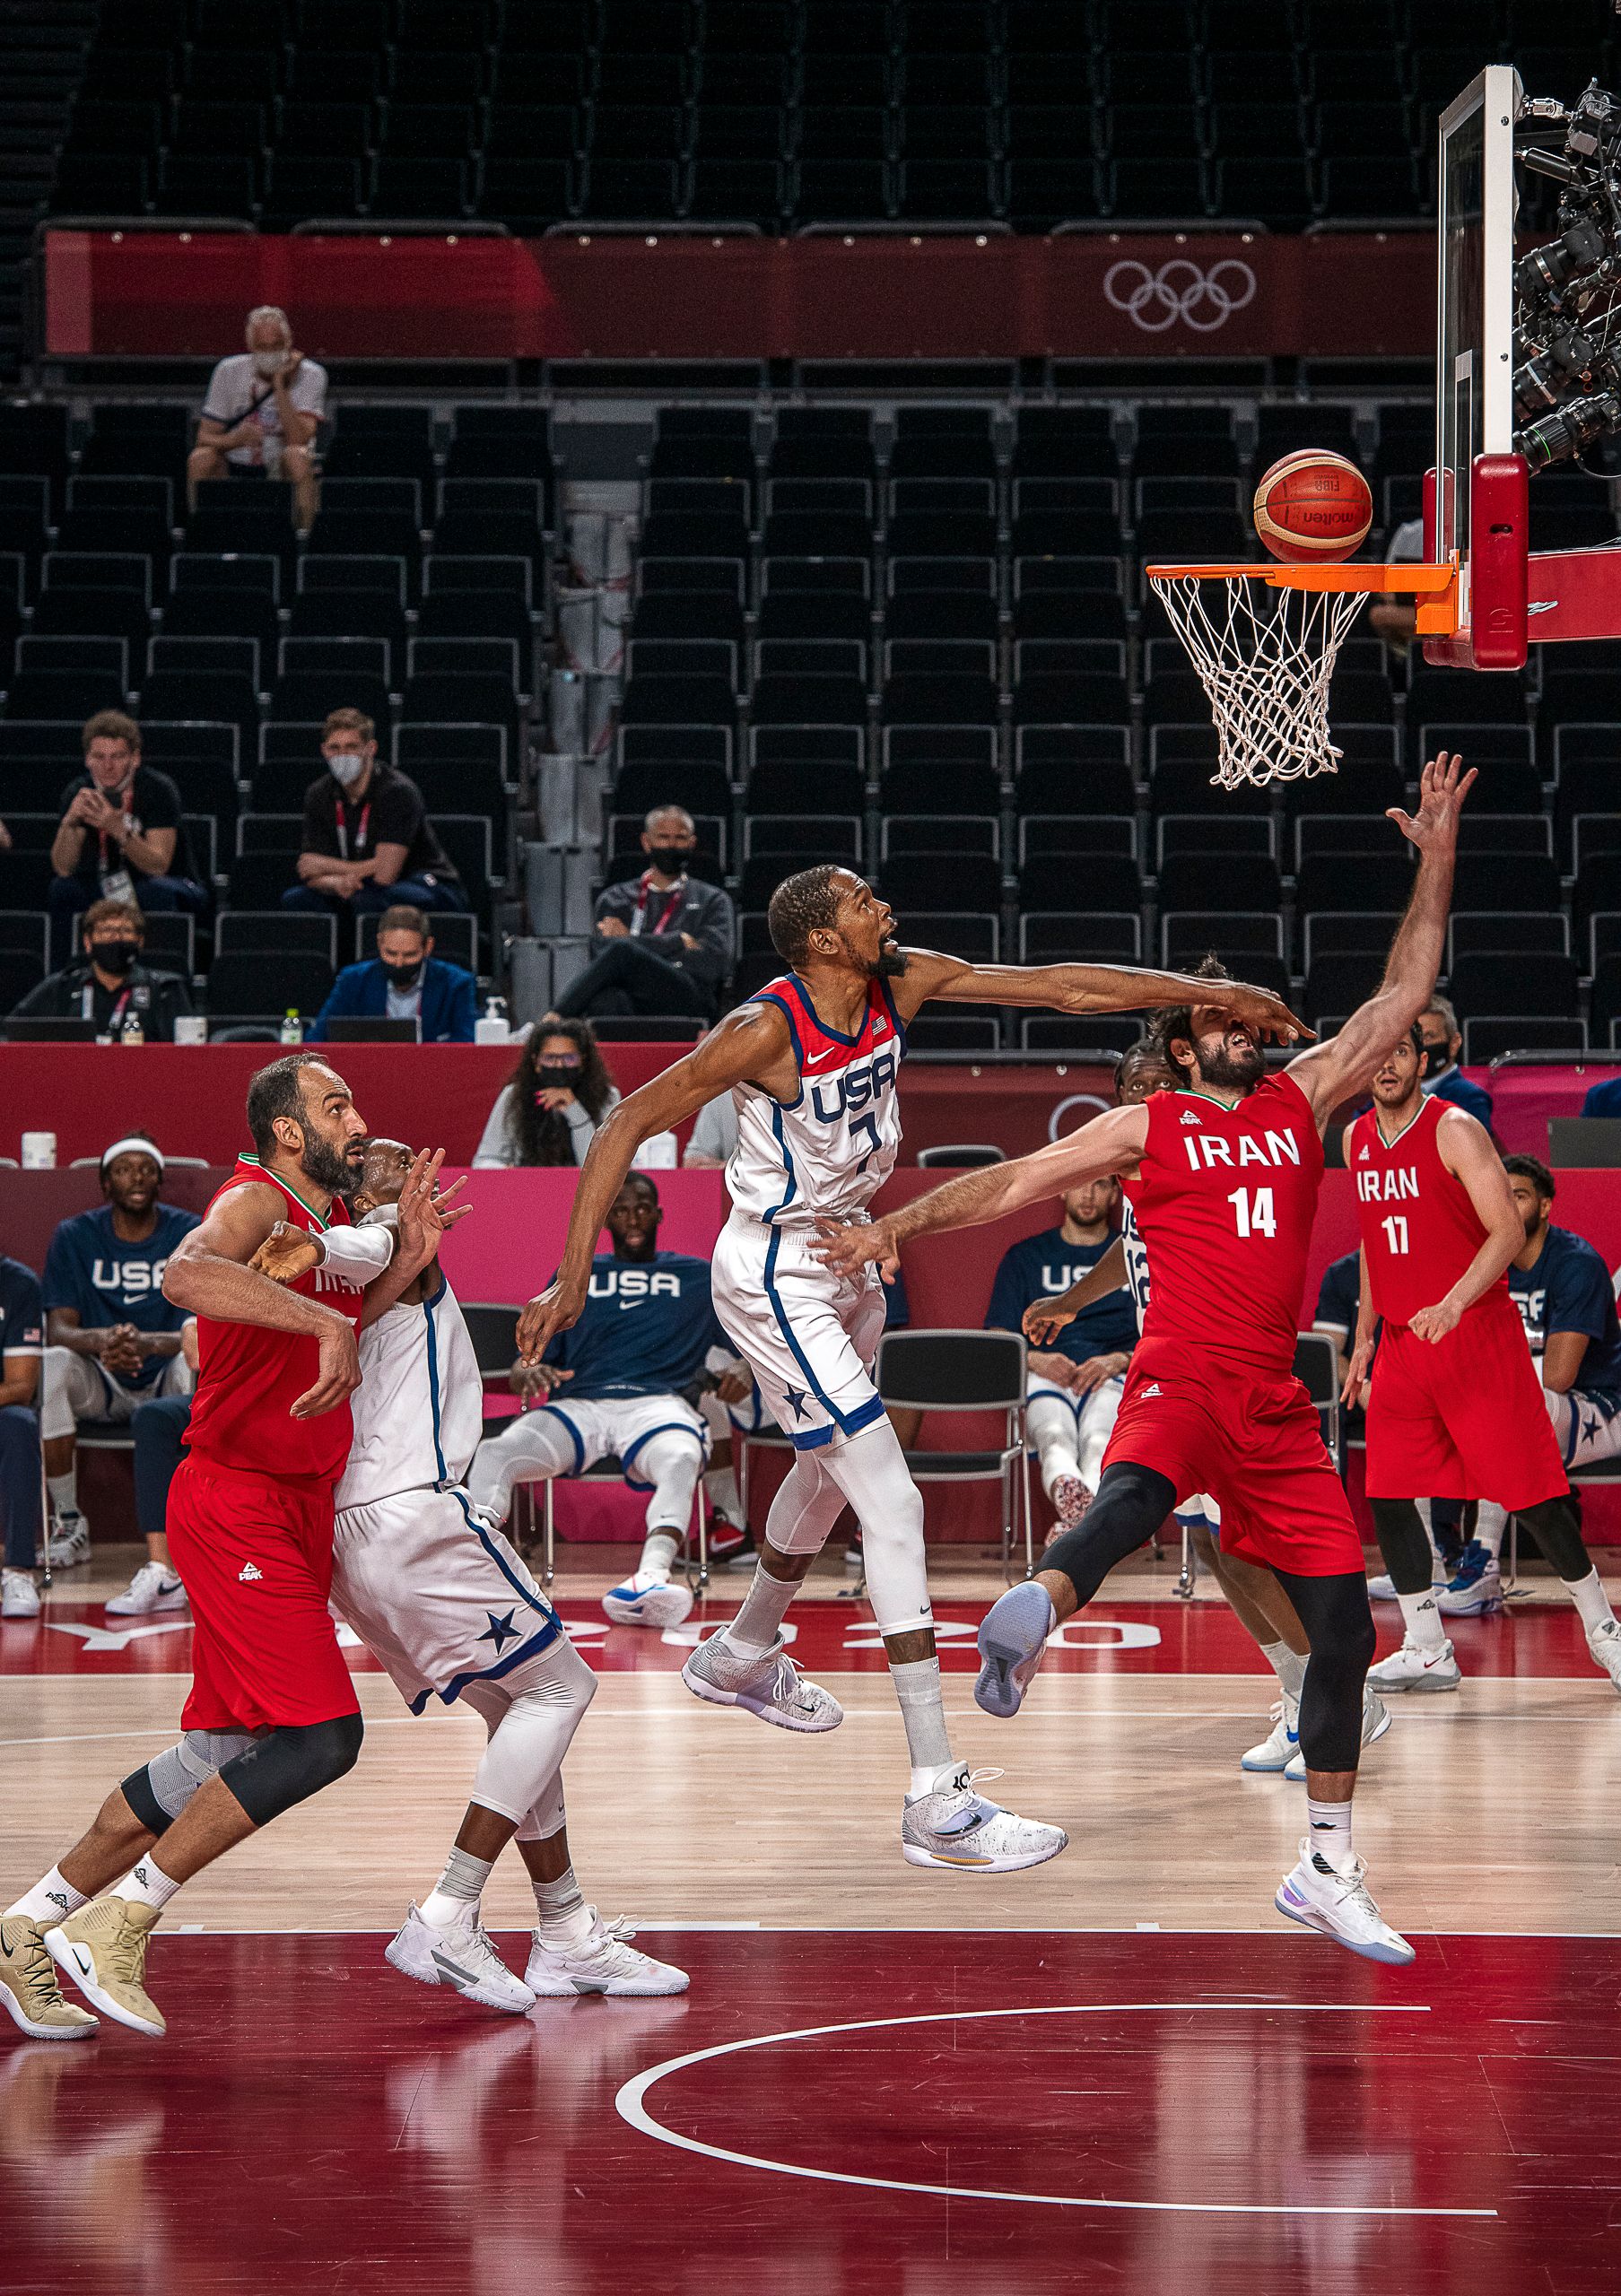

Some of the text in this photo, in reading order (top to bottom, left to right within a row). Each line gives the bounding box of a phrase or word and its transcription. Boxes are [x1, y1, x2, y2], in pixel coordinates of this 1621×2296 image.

[1303, 512, 1354, 526] molten
[810, 1052, 896, 1125] USA
[848, 1111, 883, 1177] 7
[1182, 1127, 1301, 1171] IRAN
[1356, 1166, 1420, 1202] IRAN
[1226, 1187, 1277, 1238] 14
[1381, 1215, 1409, 1255] 17
[588, 1269, 681, 1299] USA
[238, 1570, 264, 1581] PEAK
[45, 1892, 71, 1913] PEAK
